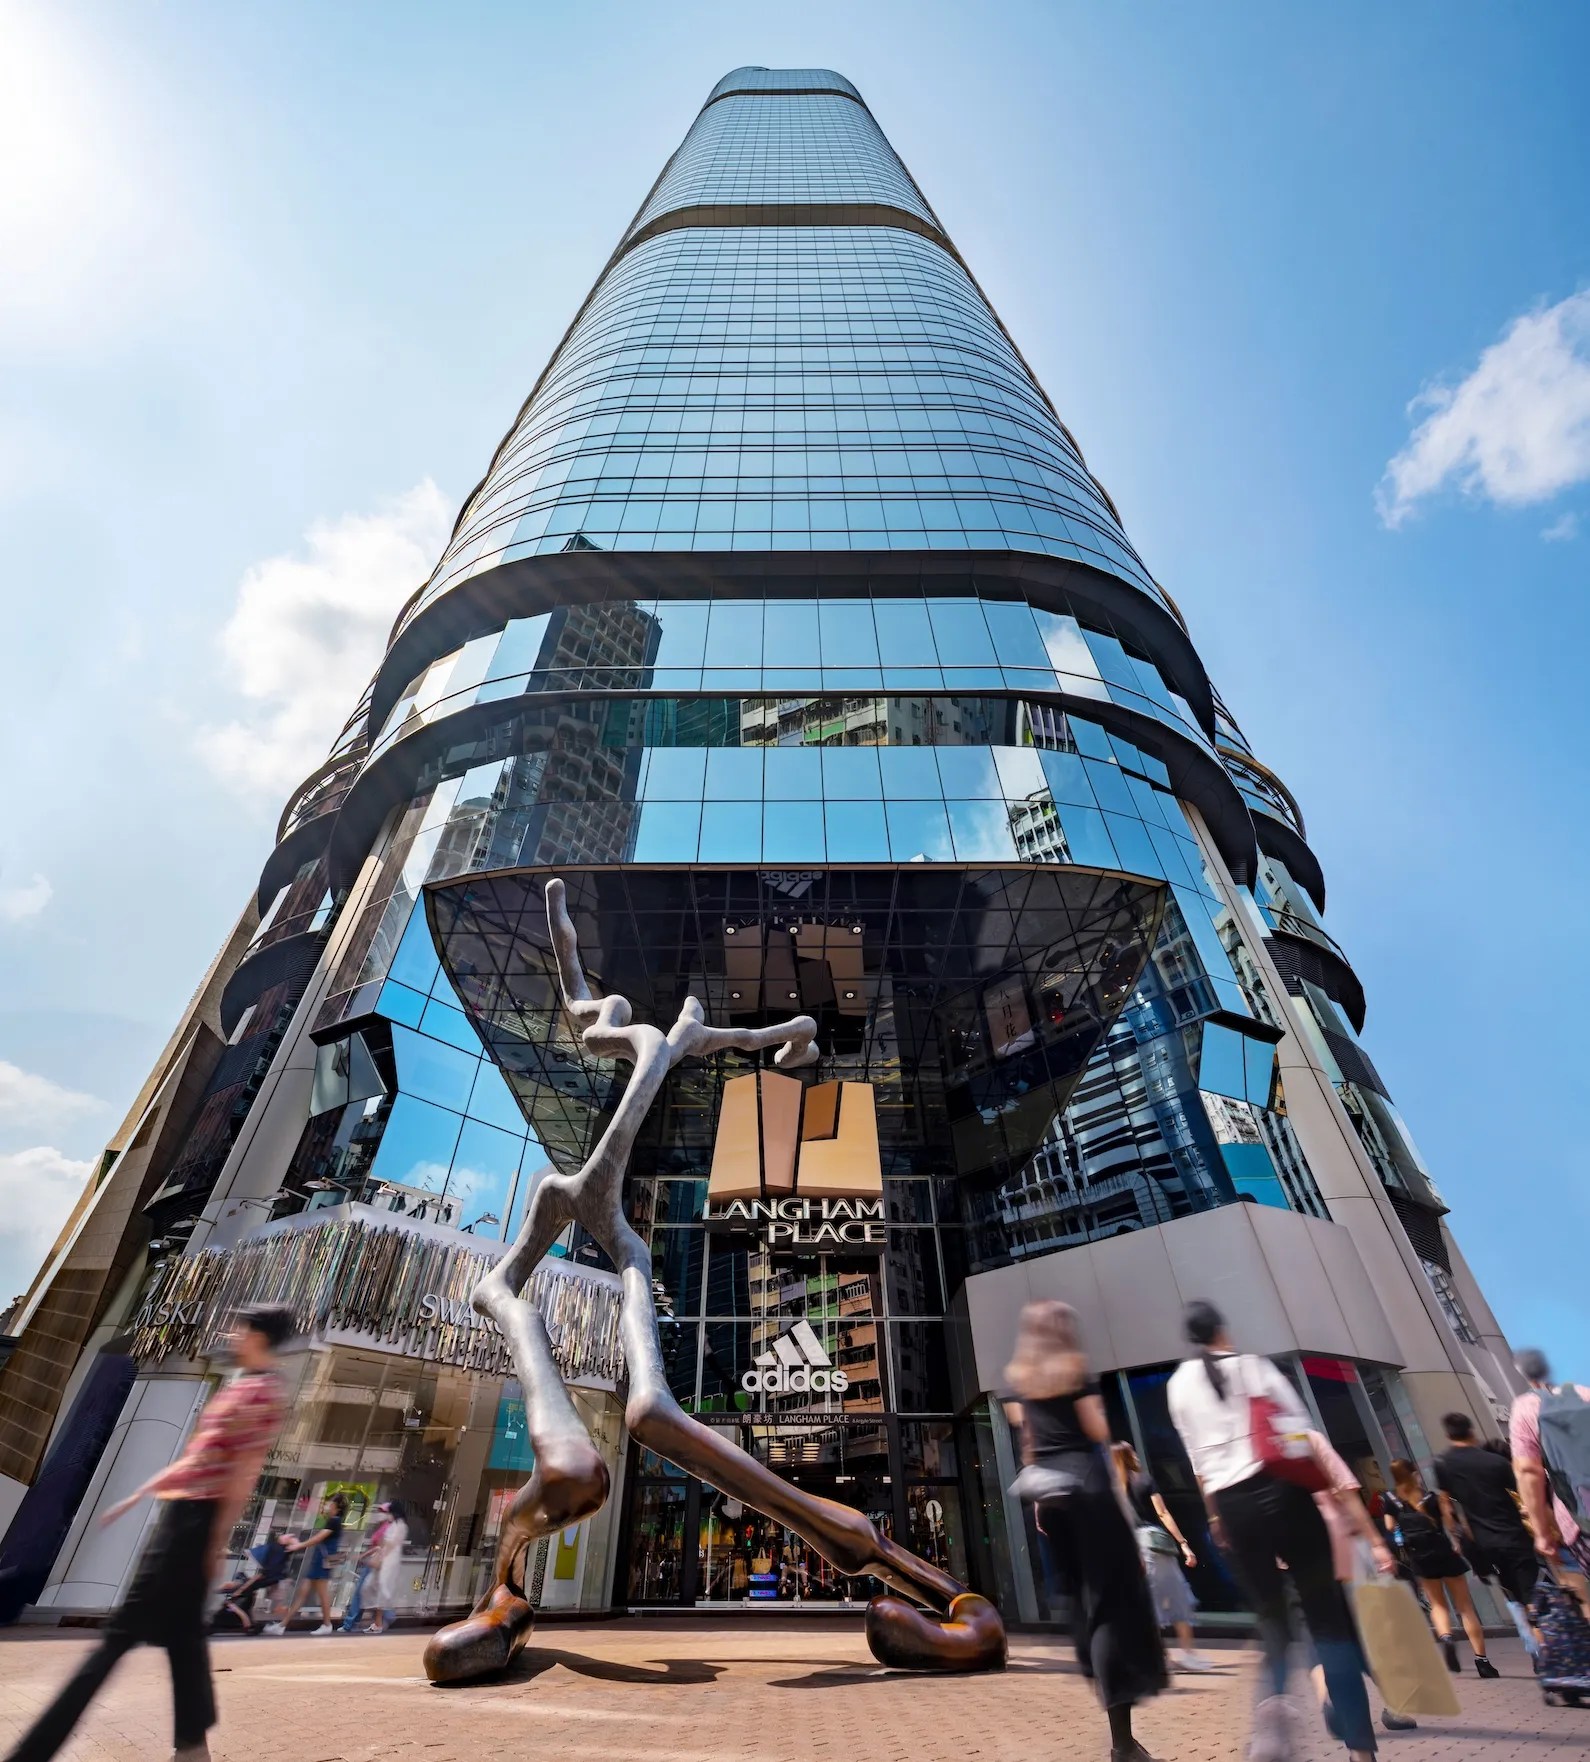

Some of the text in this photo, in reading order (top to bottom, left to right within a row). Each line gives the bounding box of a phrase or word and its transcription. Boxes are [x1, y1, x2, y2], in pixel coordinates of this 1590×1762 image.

[702, 1197, 885, 1220] LANGHAM
[767, 1221, 887, 1243] PLACE
[741, 1364, 849, 1393] adidas
[742, 1413, 773, 1424] 朗豪坊
[779, 1414, 821, 1424] LANGHAM
[823, 1414, 850, 1424] PLACE
